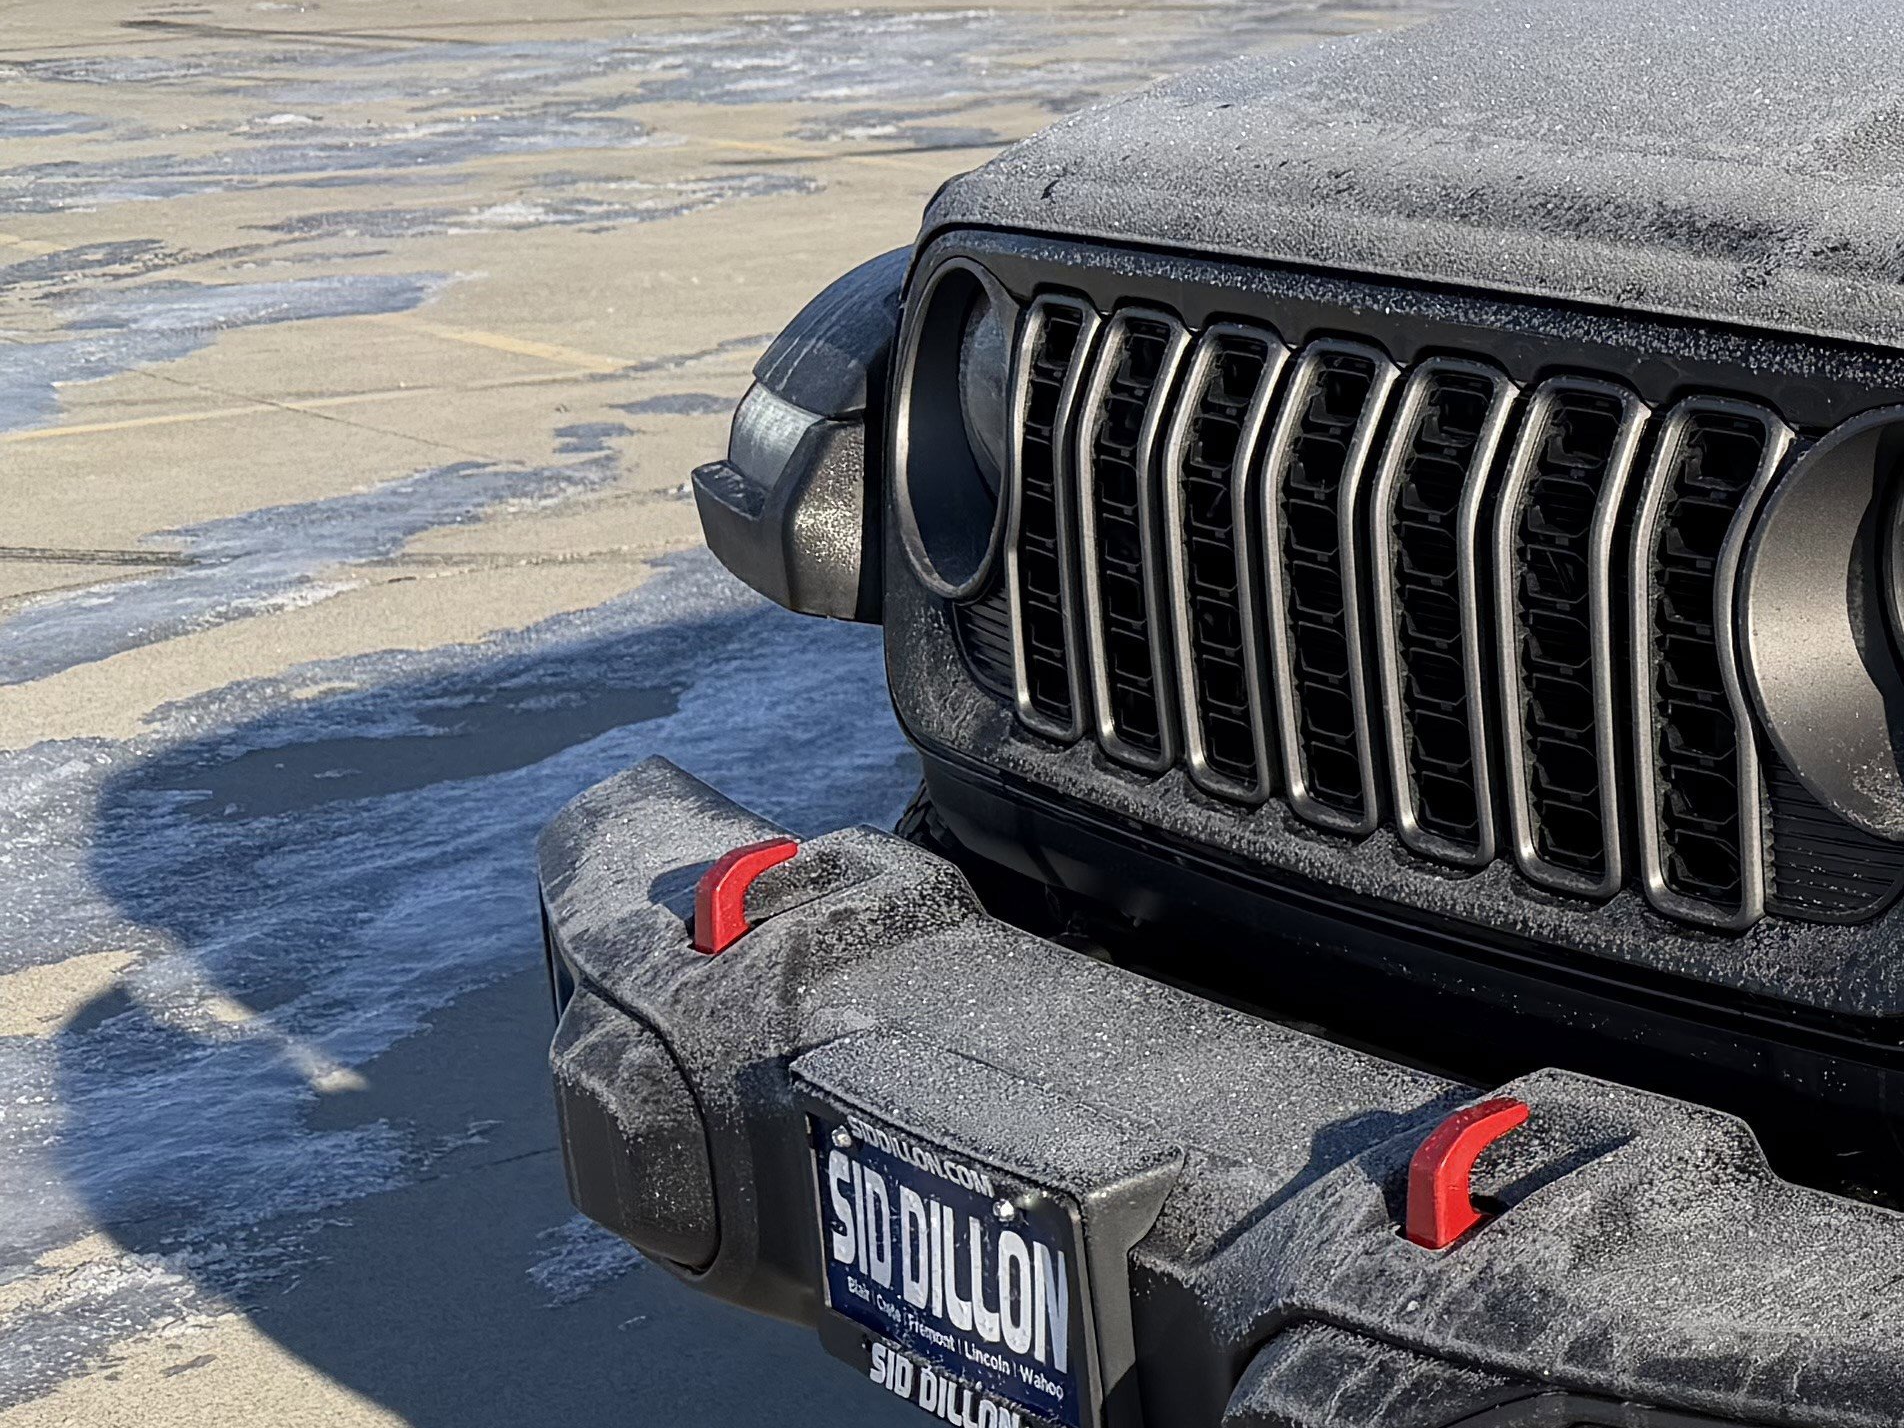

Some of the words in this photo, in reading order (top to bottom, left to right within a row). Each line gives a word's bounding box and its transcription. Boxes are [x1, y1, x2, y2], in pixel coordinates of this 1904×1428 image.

[848, 1115, 995, 1198] SIDDILLON.COM
[828, 1149, 892, 1289] SID
[900, 1184, 1070, 1374] DILLON
[869, 1341, 914, 1399] SID
[963, 1341, 1011, 1376] Lincoln
[1018, 1363, 1064, 1401] Wahoo
